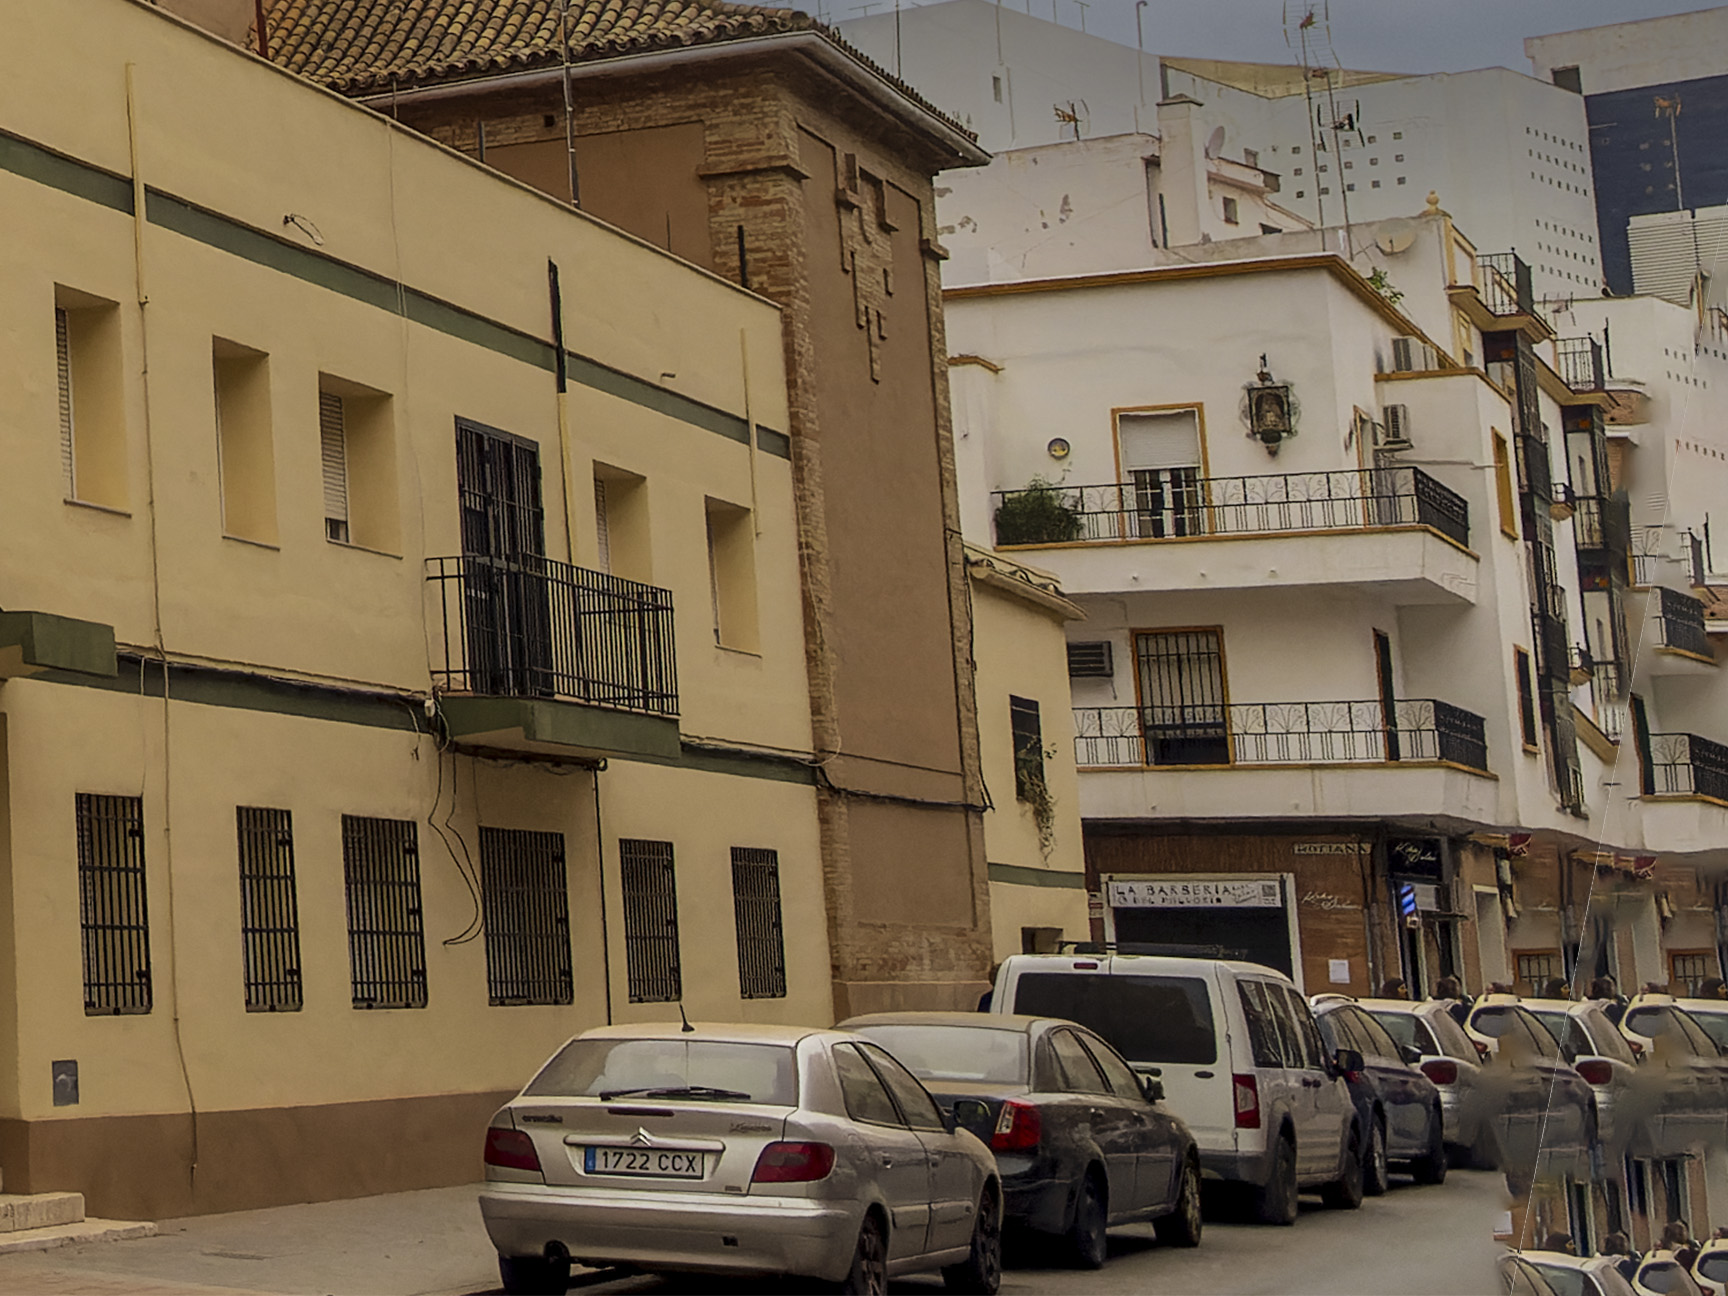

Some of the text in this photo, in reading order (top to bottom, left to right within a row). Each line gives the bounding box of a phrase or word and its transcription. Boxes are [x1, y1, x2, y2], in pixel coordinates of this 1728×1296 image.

[1116, 885, 1136, 895] LA
[602, 1150, 697, 1173] 1722 CCX
